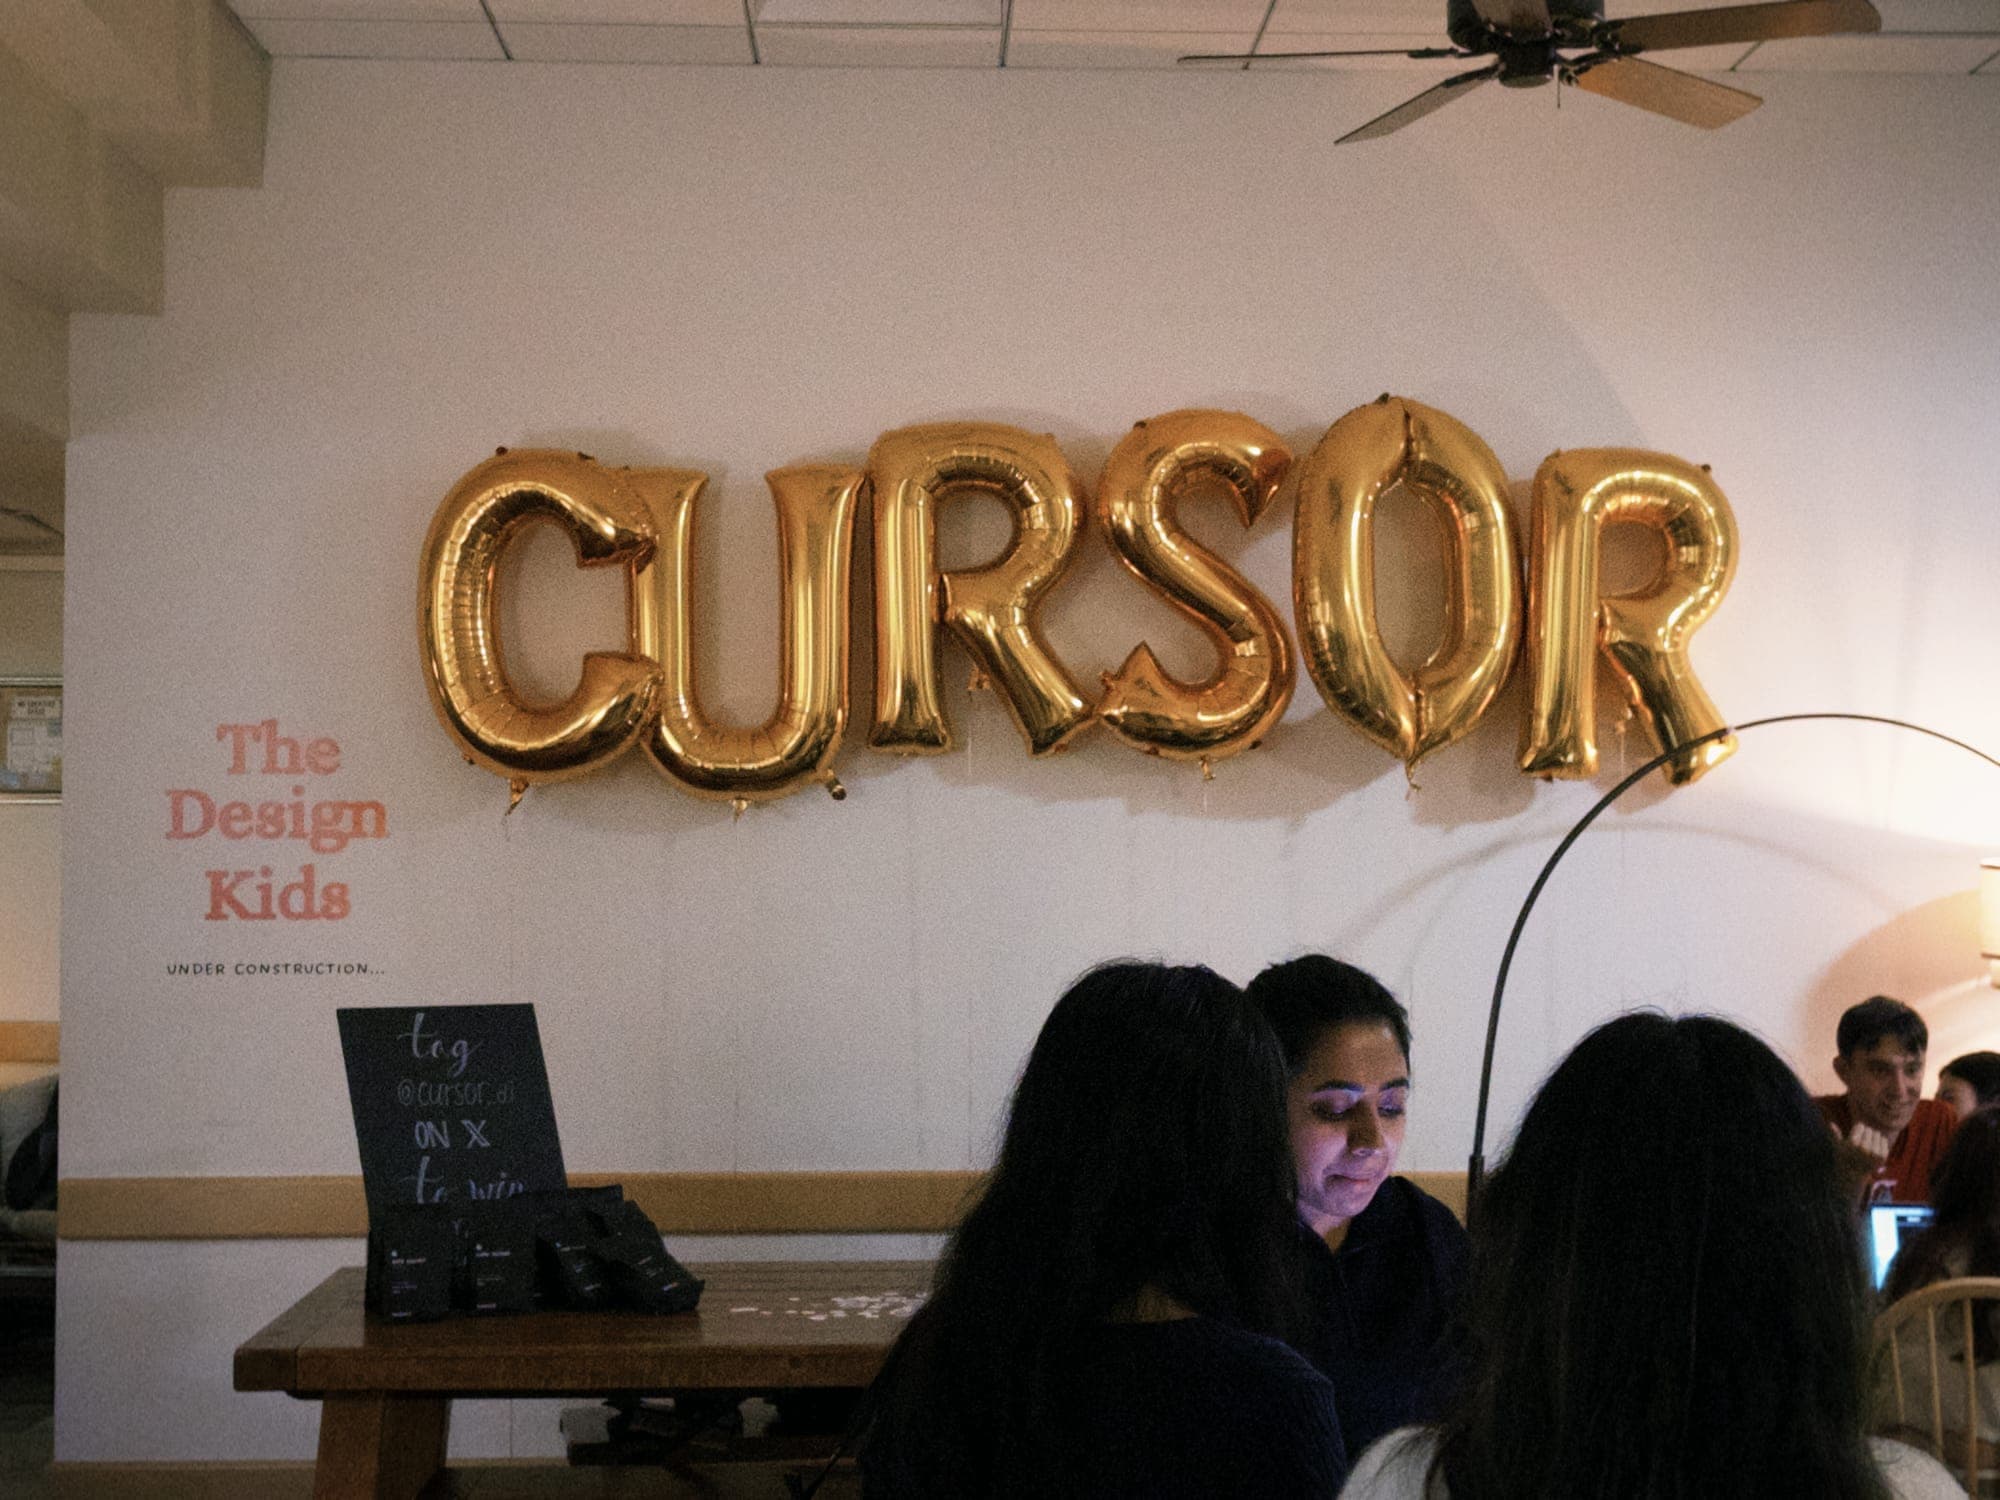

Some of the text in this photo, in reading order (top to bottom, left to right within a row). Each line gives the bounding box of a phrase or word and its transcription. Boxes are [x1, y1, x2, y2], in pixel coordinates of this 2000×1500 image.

[417, 394, 1739, 800] CURSOR
[216, 718, 342, 775] The
[165, 785, 391, 855] Design
[204, 863, 352, 922] Kids
[167, 962, 385, 976] UNDER CONSTRUCTION...
[397, 1012, 484, 1078] tag
[414, 1118, 491, 1150] ON X
